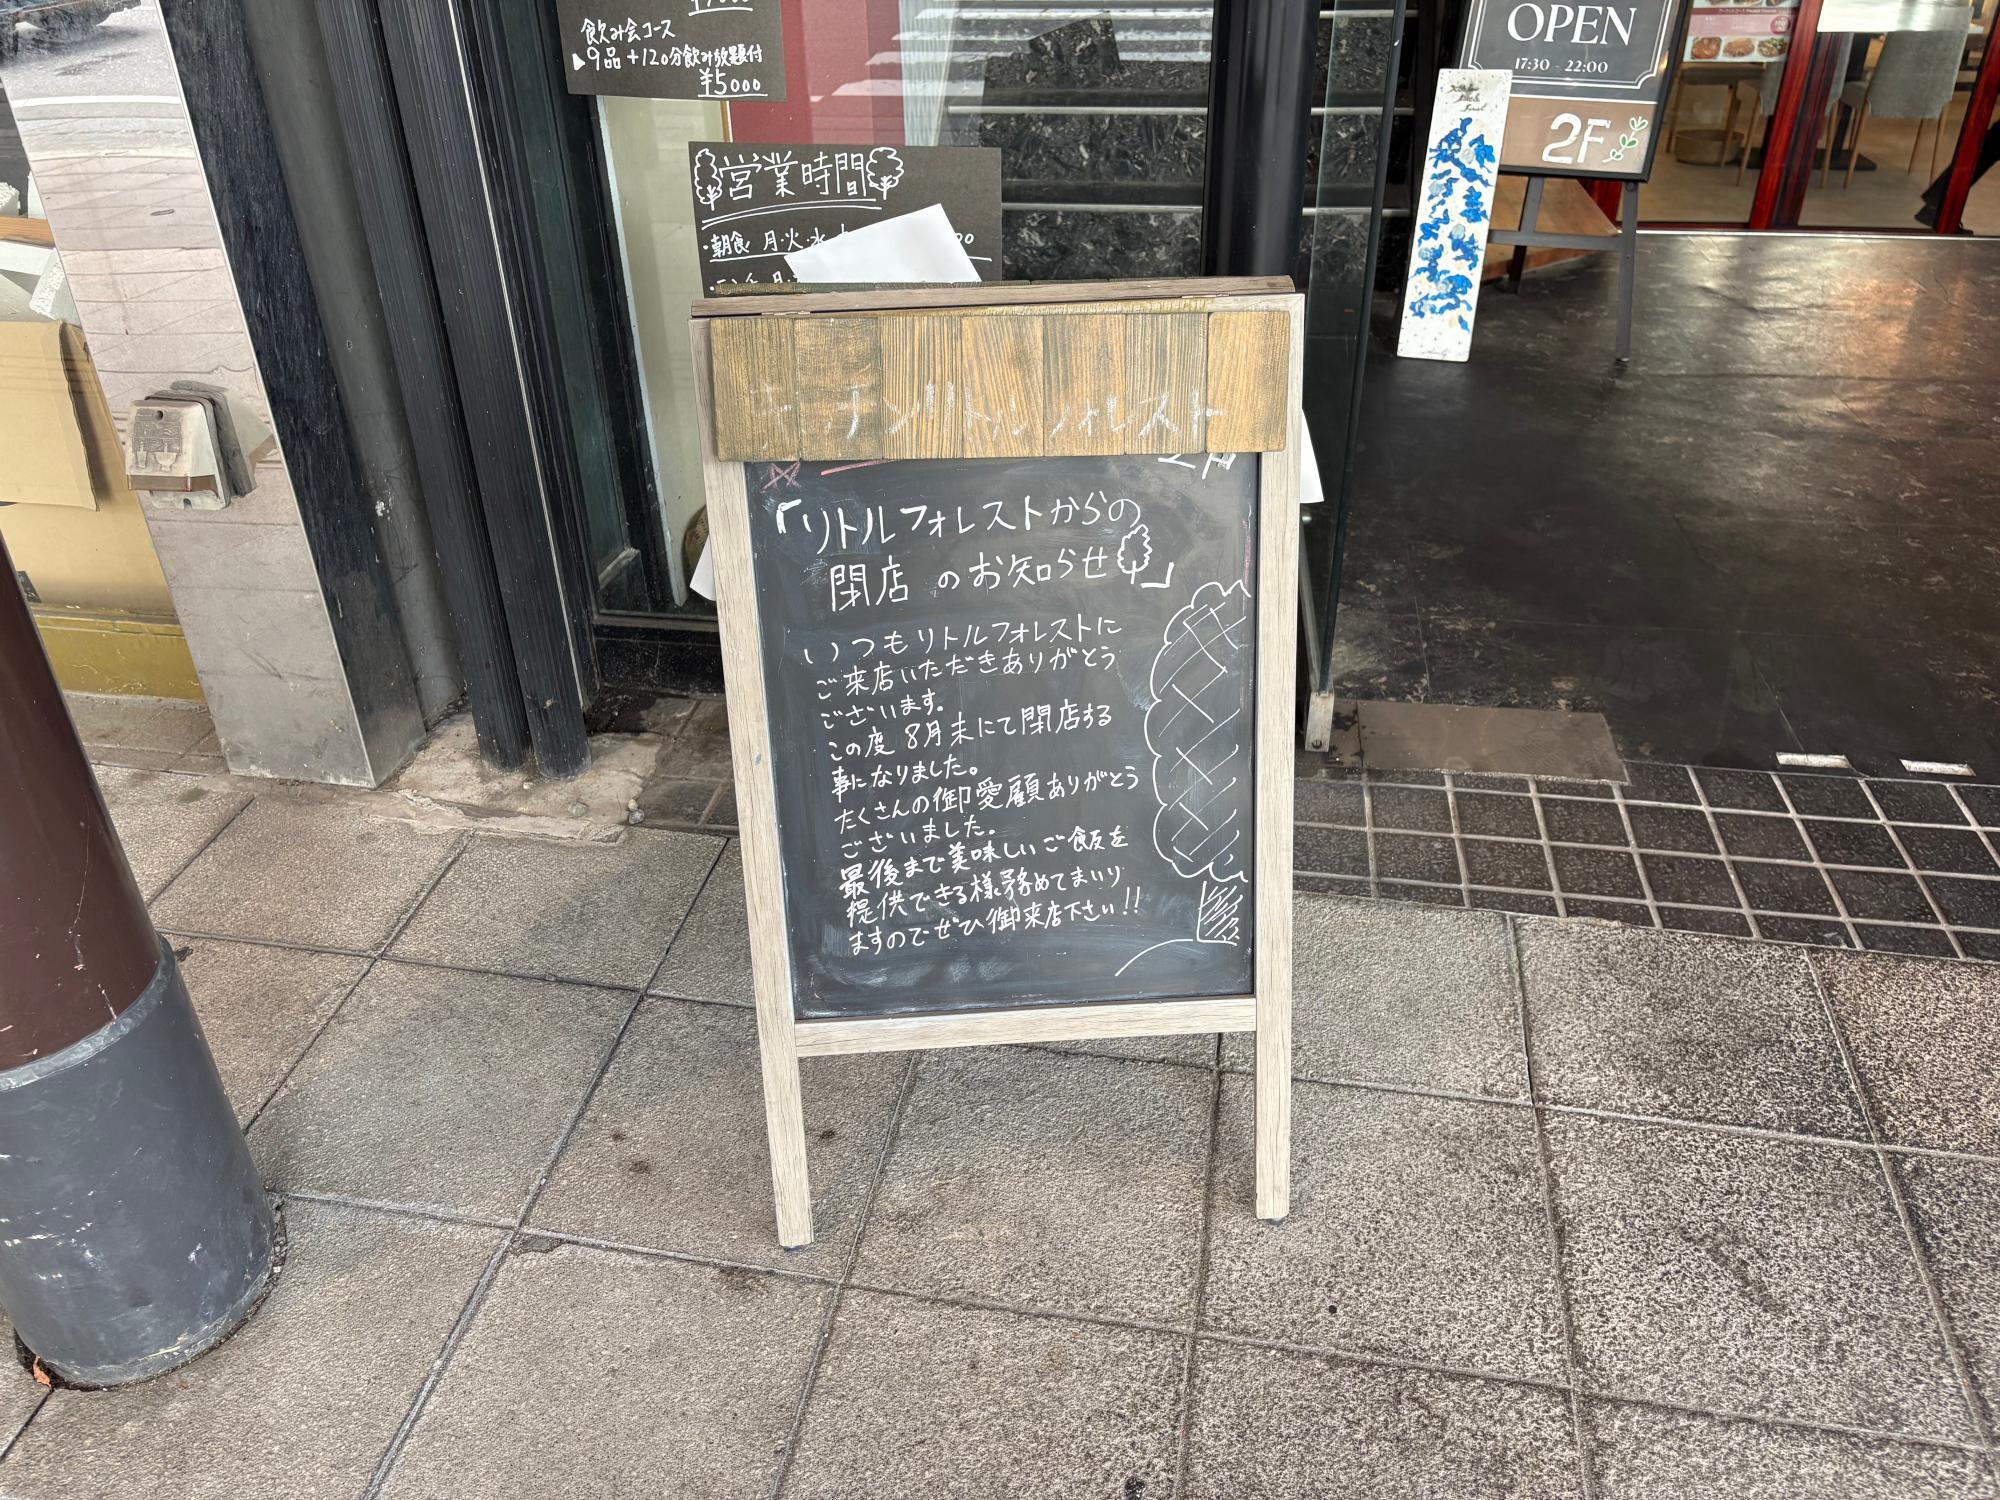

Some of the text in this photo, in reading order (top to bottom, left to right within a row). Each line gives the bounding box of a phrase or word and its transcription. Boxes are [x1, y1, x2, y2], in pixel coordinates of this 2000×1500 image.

[581, 17, 676, 44] 飲み会コース
[1507, 3, 1637, 46] OPEN
[699, 67, 761, 95] ¥5000
[1515, 57, 1550, 72] 17:30
[1564, 60, 1608, 73] 22:00
[1542, 113, 1611, 164] 2F
[718, 150, 868, 201] 営業時間
[816, 646, 1117, 700] ご来店いただきありがとう
[831, 753, 978, 803] 事になりました。
[834, 765, 1139, 835] たくさんの御愛顧ありがとう
[838, 825, 1129, 900] 最後まで美味しいご飯を
